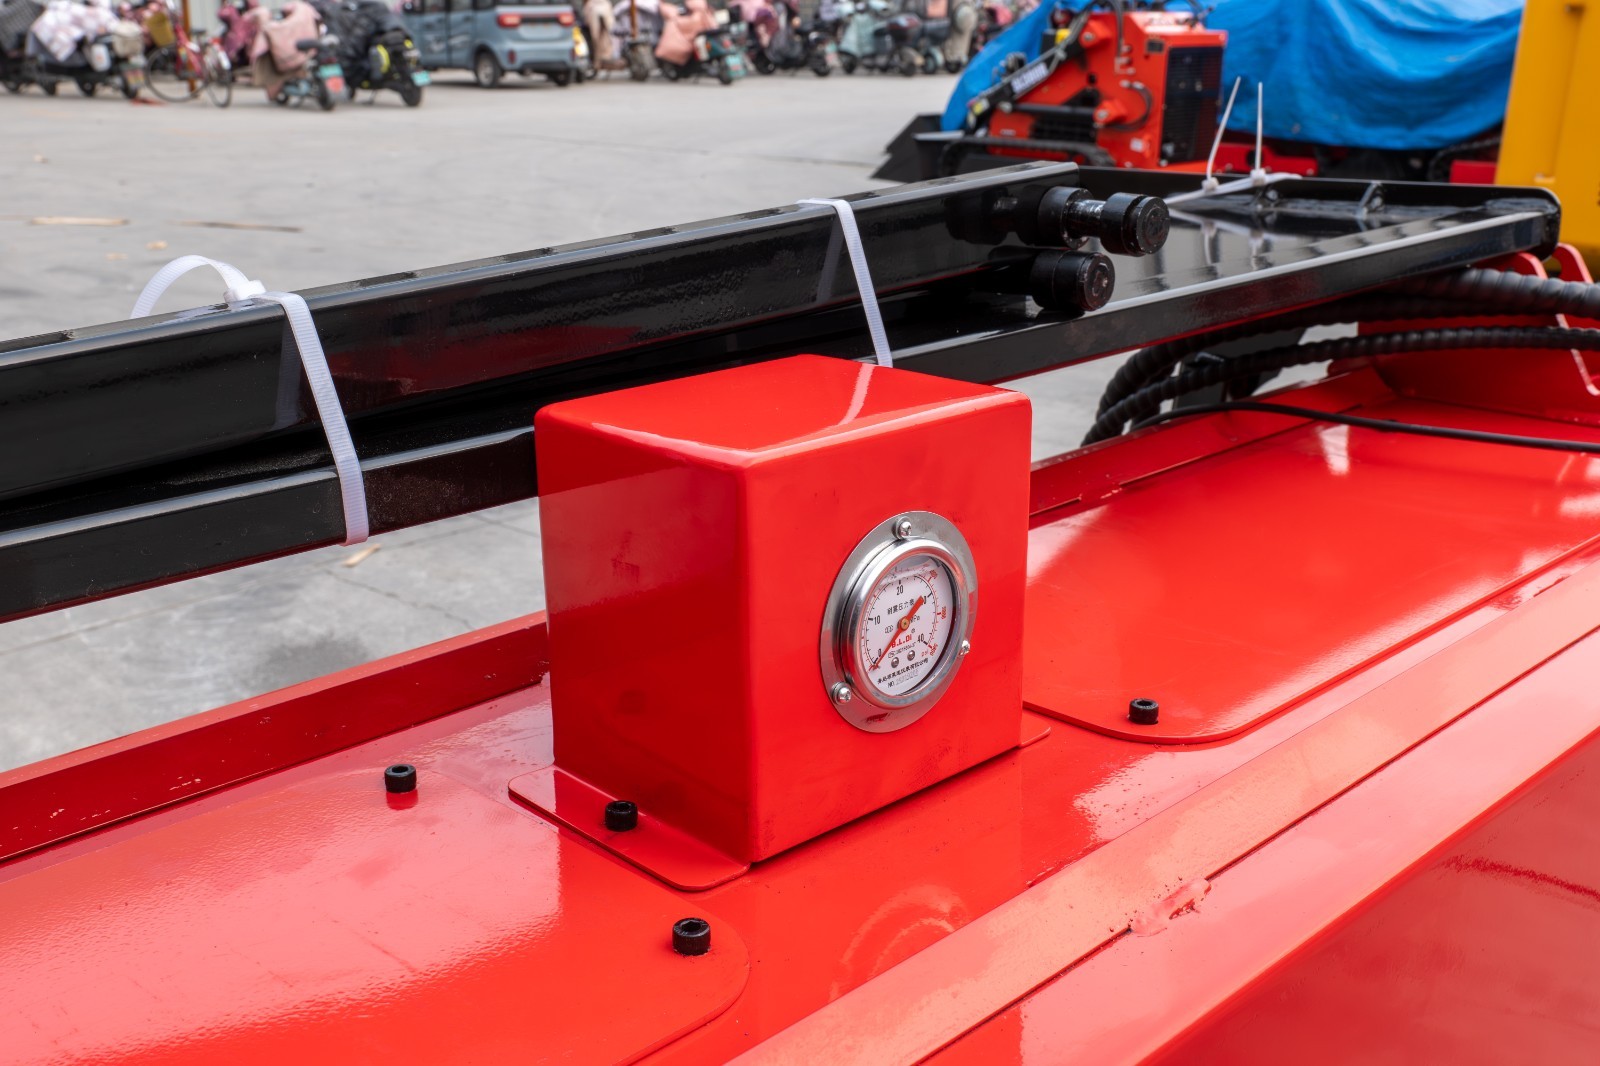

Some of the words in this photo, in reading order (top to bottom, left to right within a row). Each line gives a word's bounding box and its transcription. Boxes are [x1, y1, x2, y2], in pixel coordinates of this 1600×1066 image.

[896, 584, 904, 596] 20
[873, 615, 881, 626] 10
[917, 633, 925, 644] 40
